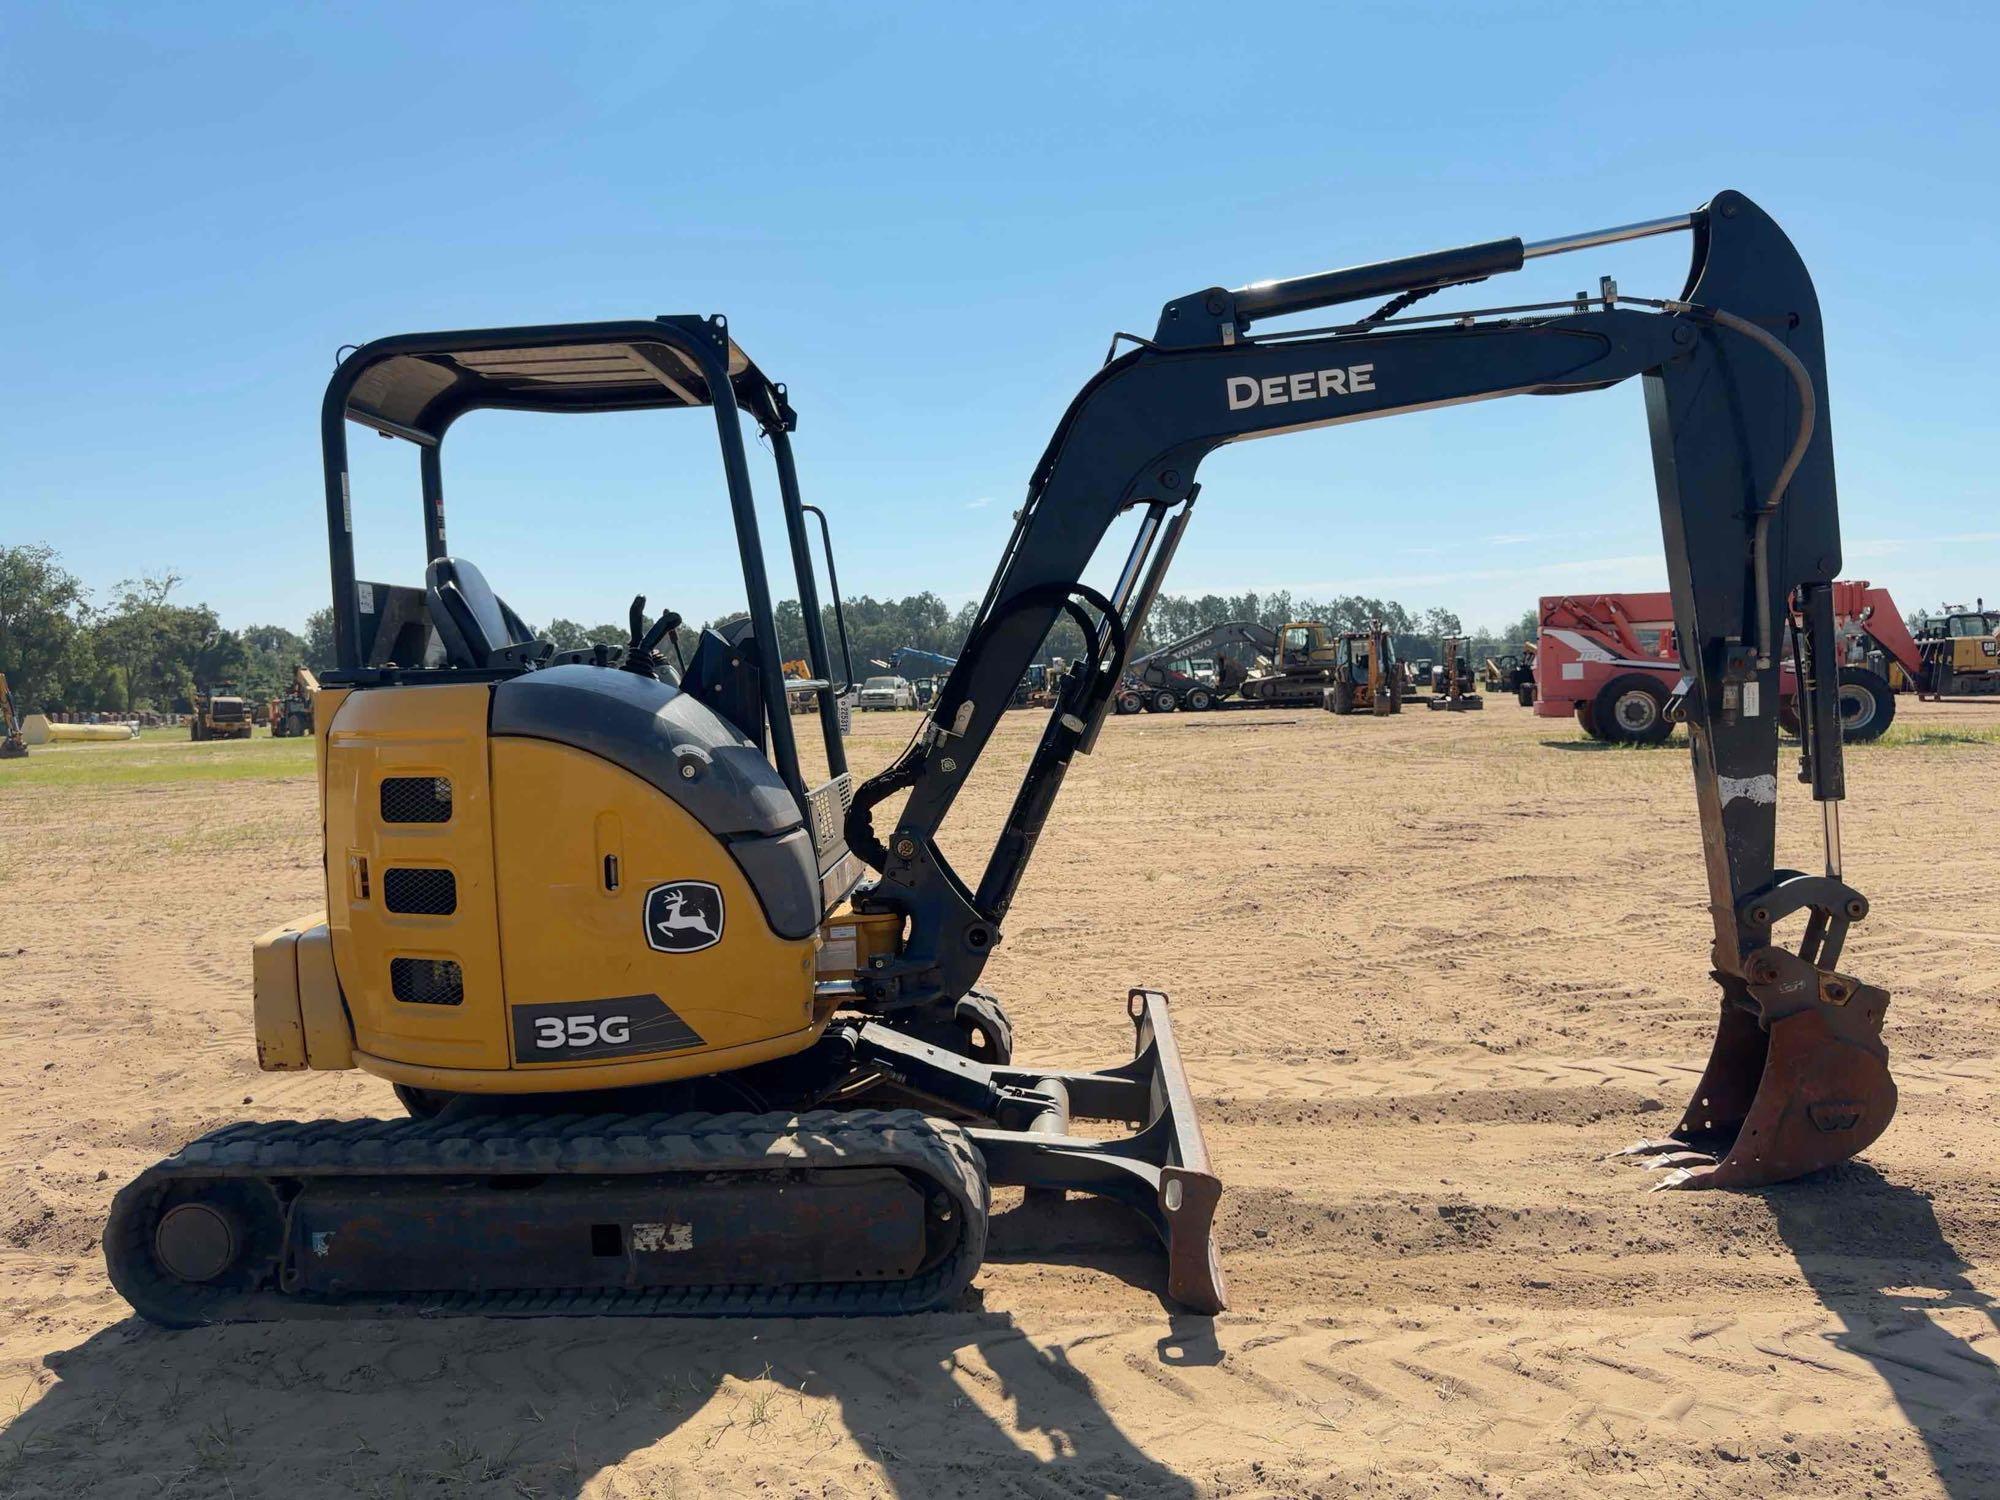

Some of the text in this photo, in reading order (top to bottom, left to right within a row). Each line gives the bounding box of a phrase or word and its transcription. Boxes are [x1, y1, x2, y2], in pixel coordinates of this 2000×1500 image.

[1226, 363, 1376, 411] DEERE
[1173, 640, 1212, 659] VOLVO
[1984, 642, 1995, 651] CAT
[840, 707, 849, 732] 225312
[535, 1015, 630, 1049] 35G
